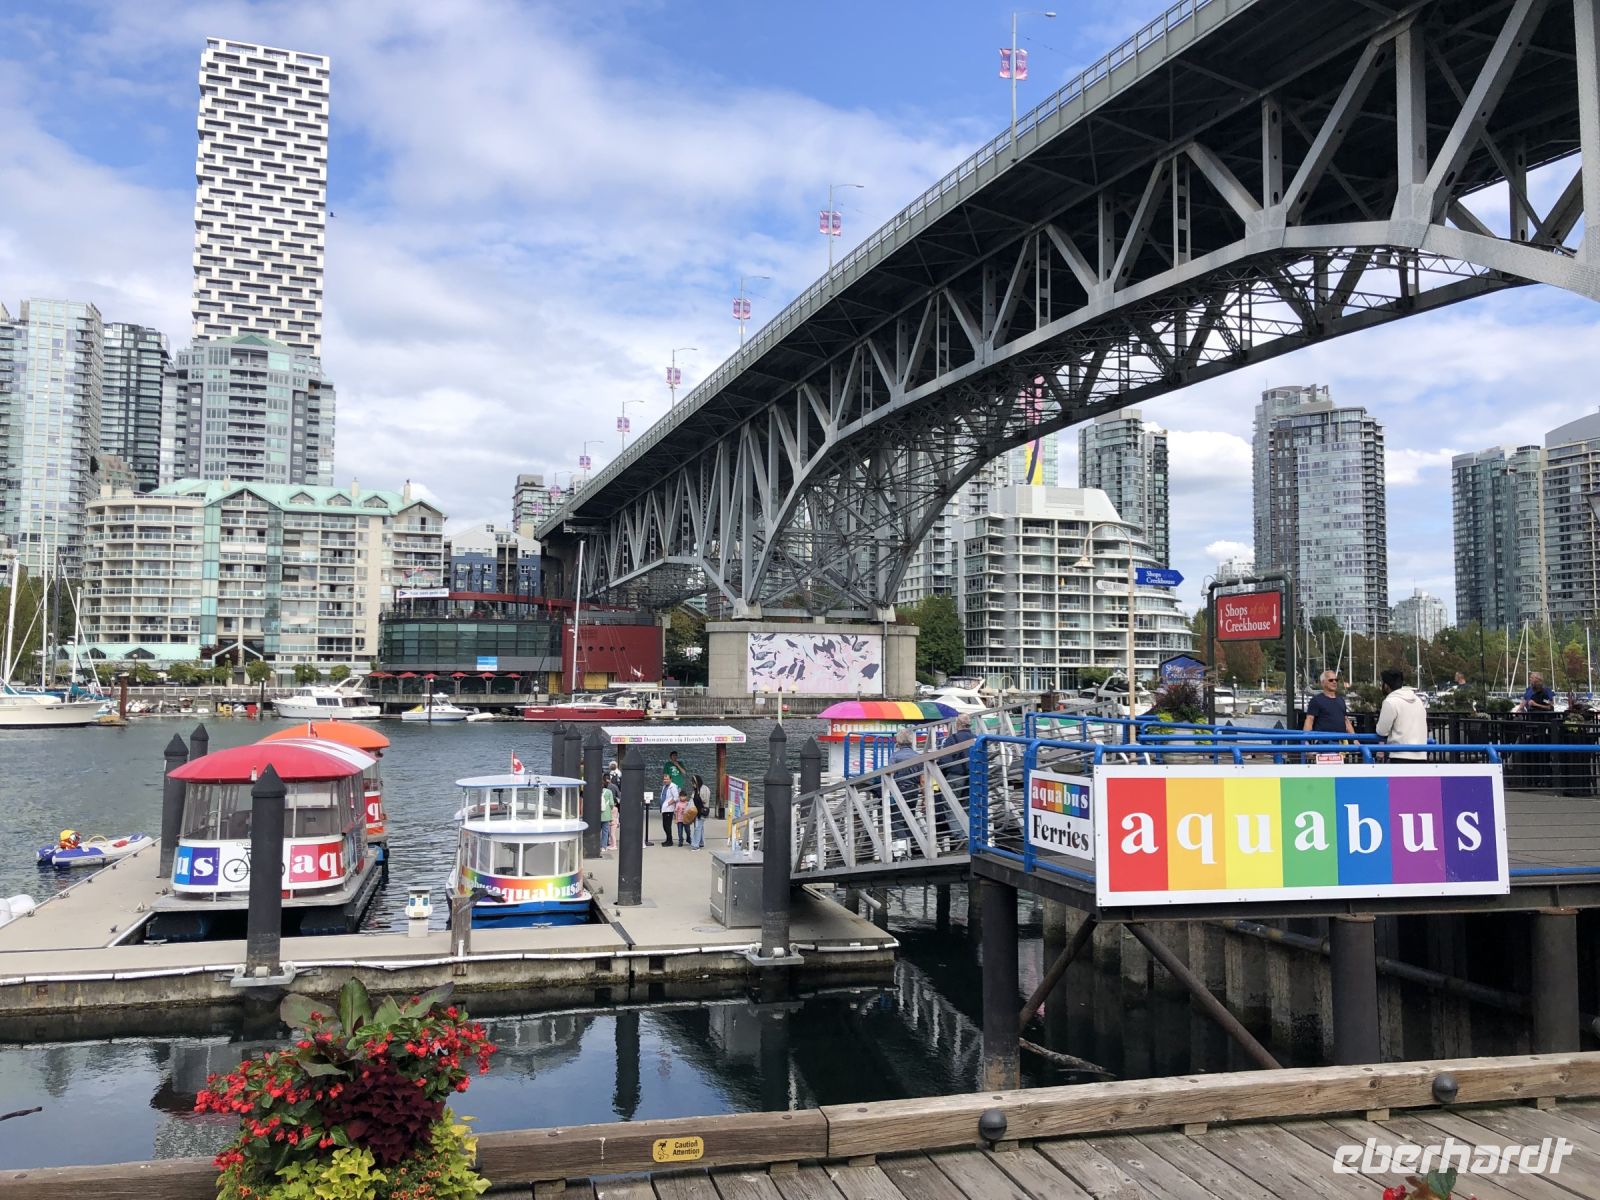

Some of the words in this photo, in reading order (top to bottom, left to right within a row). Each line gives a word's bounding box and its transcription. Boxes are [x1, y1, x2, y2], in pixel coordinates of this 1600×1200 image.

[1146, 570, 1162, 579] Shops
[1225, 602, 1248, 621] Shops
[1225, 617, 1271, 633] Creekhouse
[1032, 783, 1088, 809] aquabus
[1032, 814, 1089, 851] Ferries
[1120, 802, 1483, 866] aquabus
[672, 1147, 700, 1156] Attention
[674, 1139, 699, 1149] Caution
